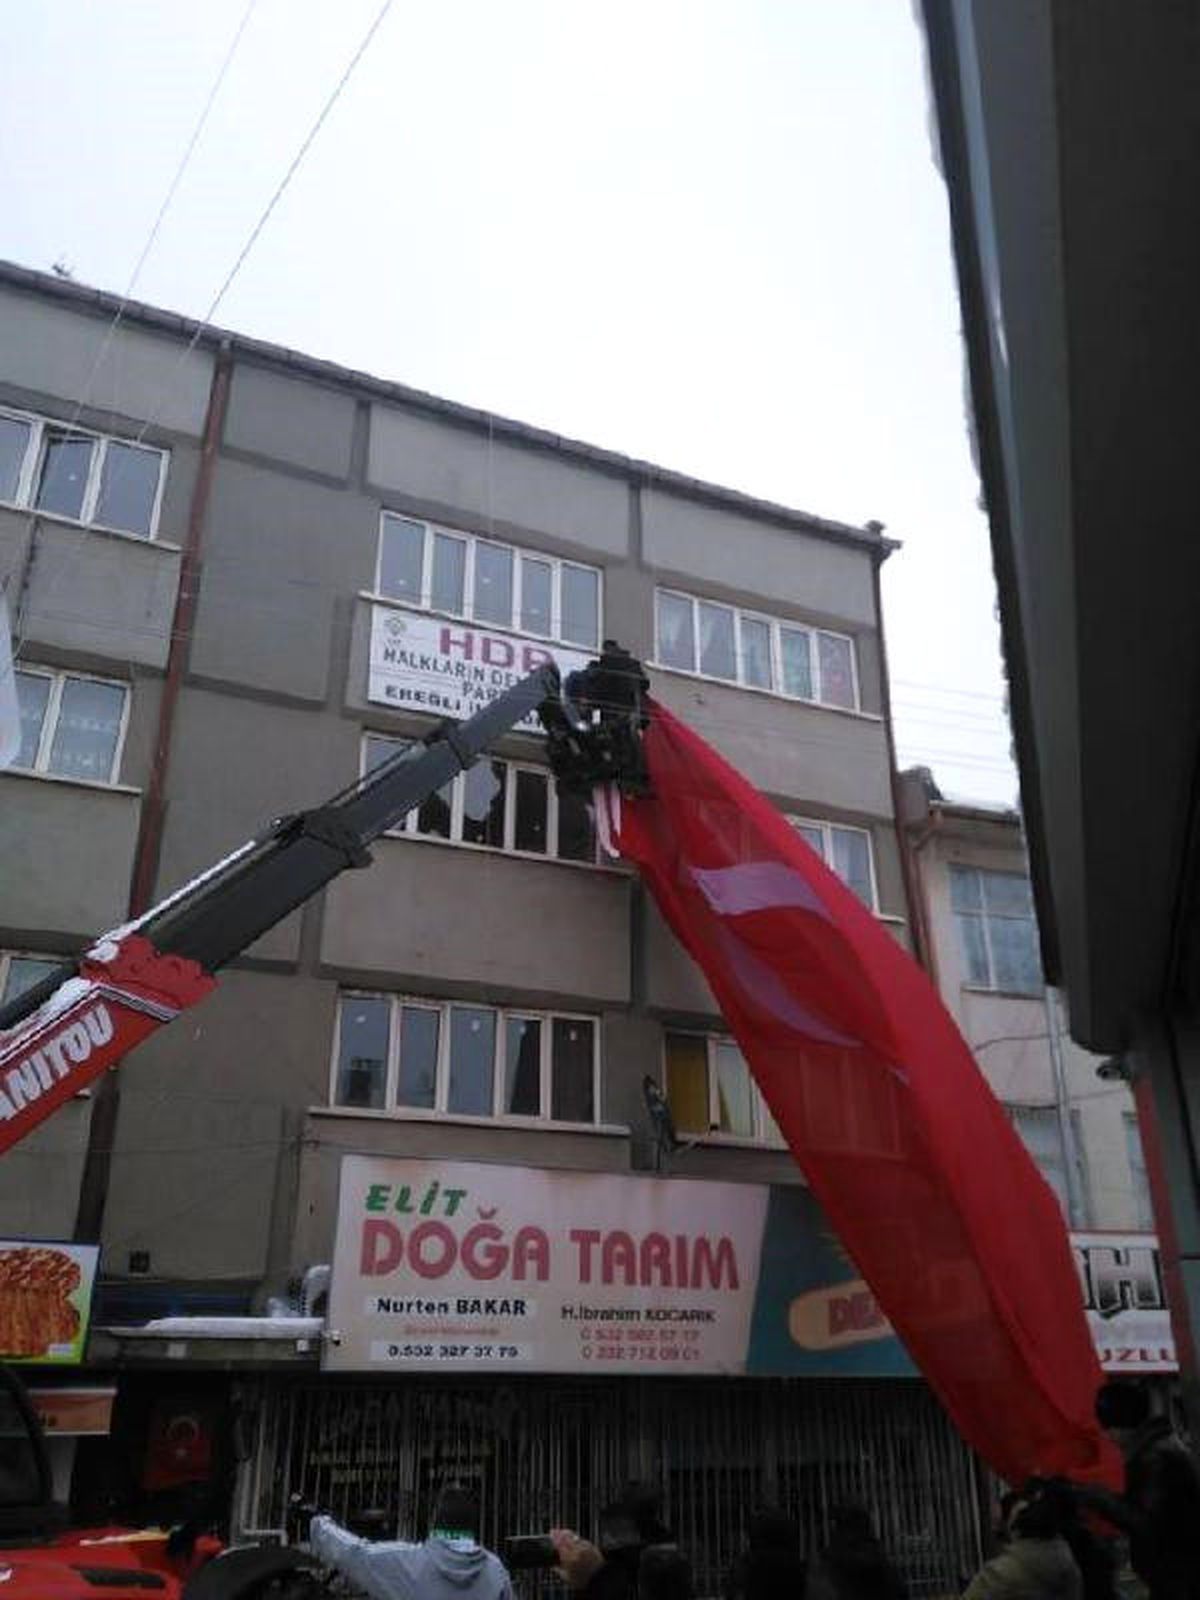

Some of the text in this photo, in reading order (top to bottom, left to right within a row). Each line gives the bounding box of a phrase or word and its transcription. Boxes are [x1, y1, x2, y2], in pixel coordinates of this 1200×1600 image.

[440, 628, 553, 673] HDP
[360, 1207, 740, 1291] DOĞA TARIM
[377, 1298, 526, 1317] Nurten BAKAR
